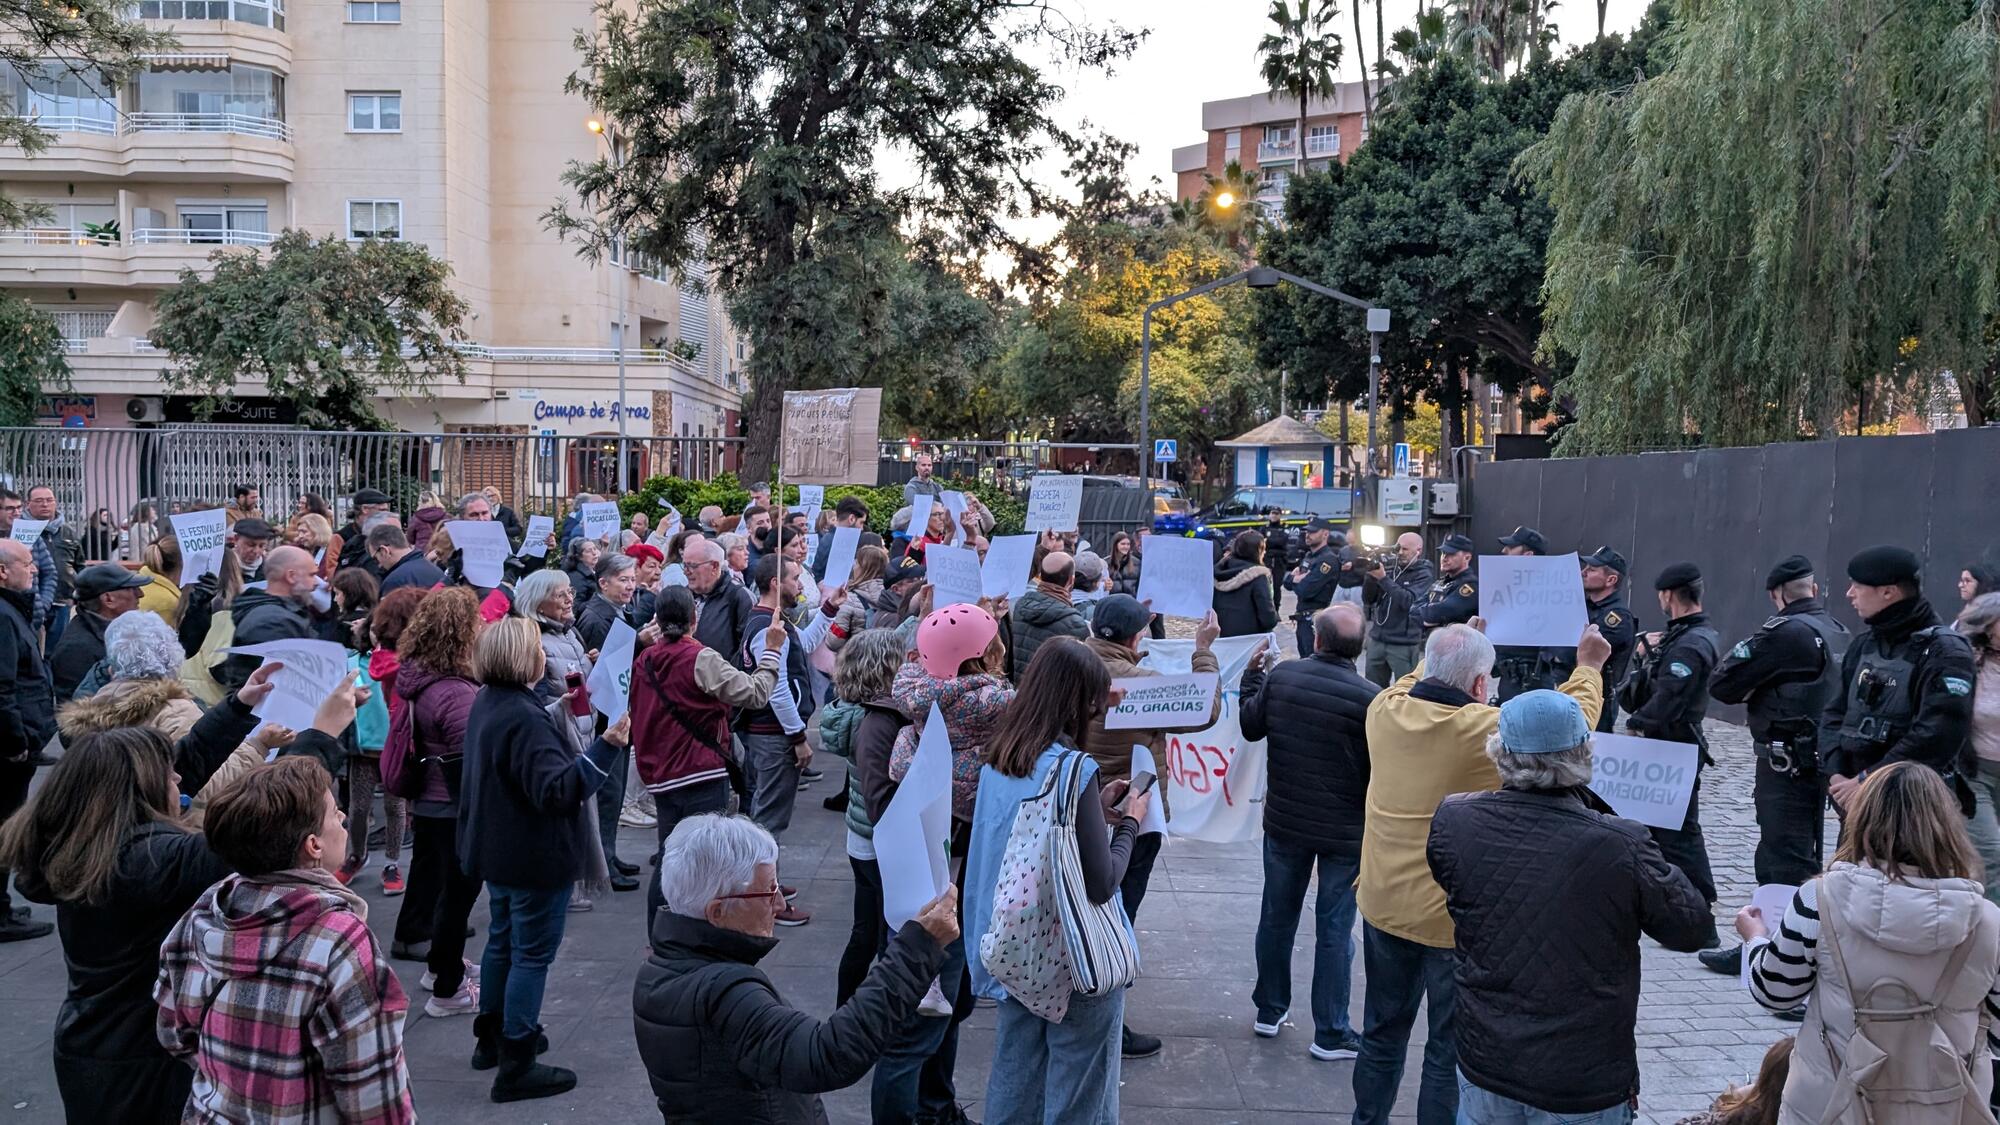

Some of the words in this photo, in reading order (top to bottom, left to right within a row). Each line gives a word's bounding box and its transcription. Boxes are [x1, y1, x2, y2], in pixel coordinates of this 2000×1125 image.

[242, 407, 277, 419] SUITE
[534, 400, 585, 424] Campo
[590, 401, 605, 418] de
[610, 401, 651, 421] Arroz
[14, 533, 26, 542] NO
[183, 537, 213, 553] POCAS
[1167, 689, 1207, 699] COSTA?
[1114, 704, 1138, 716] NO,
[1142, 701, 1204, 713] GRACIAS
